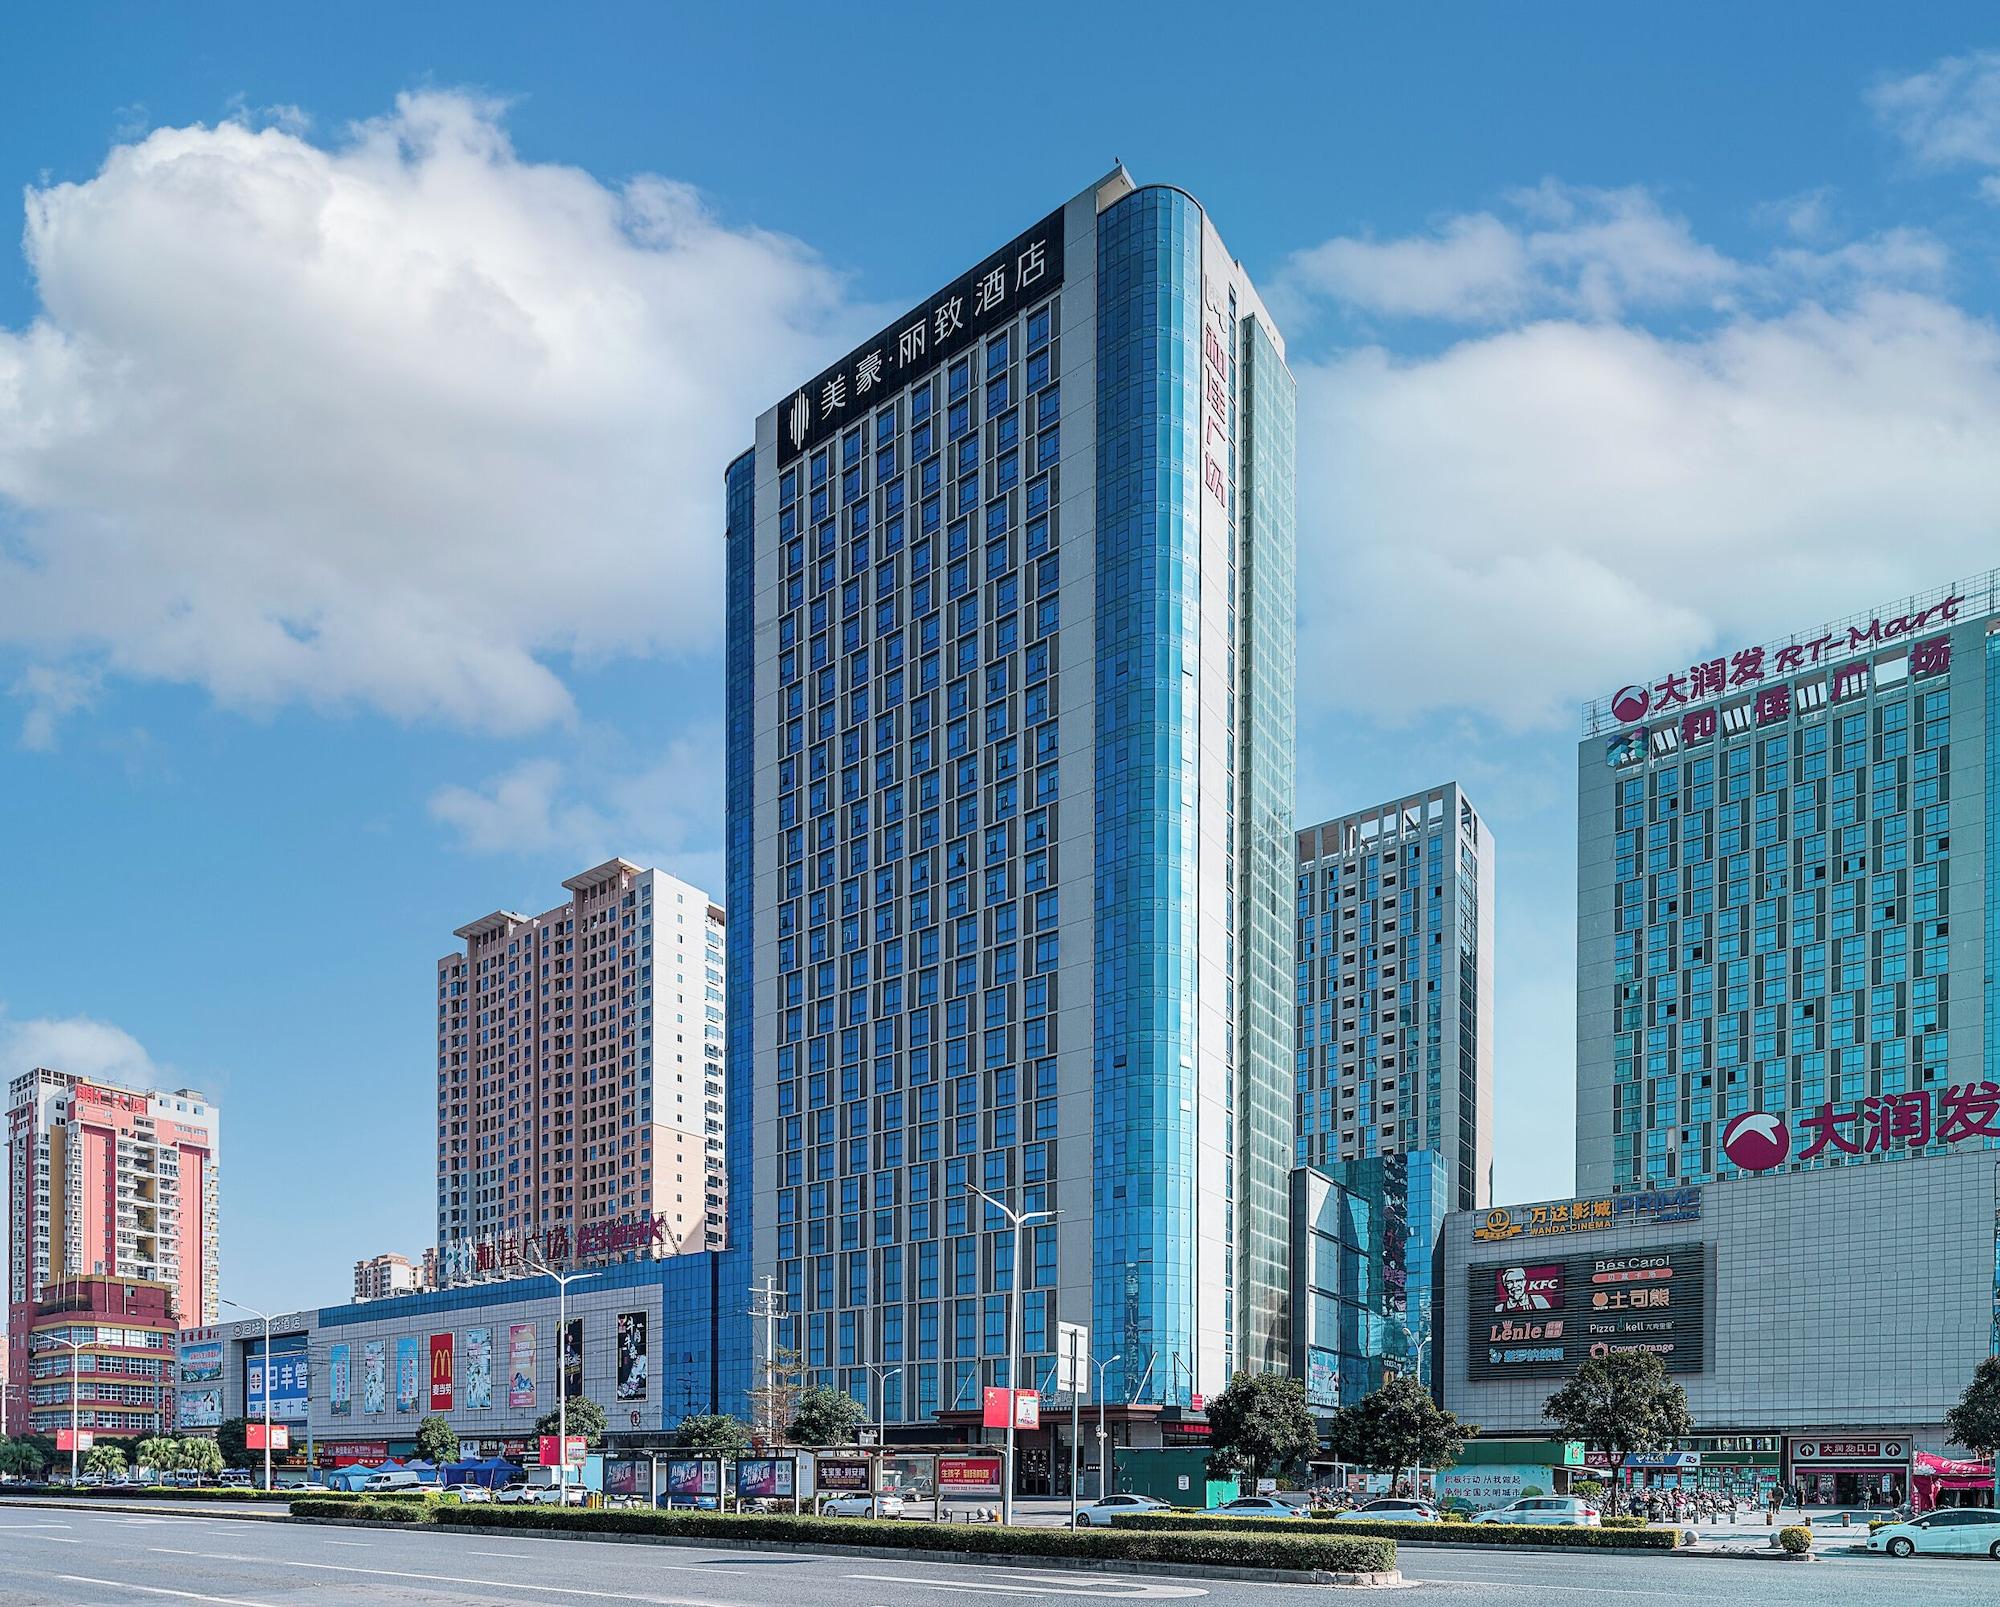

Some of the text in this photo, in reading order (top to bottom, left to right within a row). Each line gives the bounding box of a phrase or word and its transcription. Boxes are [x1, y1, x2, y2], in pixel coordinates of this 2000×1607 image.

[1653, 595, 1965, 711] 大润发 RT-Mart
[1797, 1081, 2000, 1160] 大润发
[1531, 1200, 1612, 1225] 万达影城
[1531, 1219, 1612, 1236] WANDA CINEMA
[1628, 1255, 1670, 1268] Carol
[1528, 1278, 1559, 1291] KFC
[1609, 1288, 1670, 1307] 土司熊
[1590, 1323, 1615, 1334] Pizza
[1610, 1343, 1674, 1354] Cover Orange
[433, 1383, 452, 1396] 麦当劳
